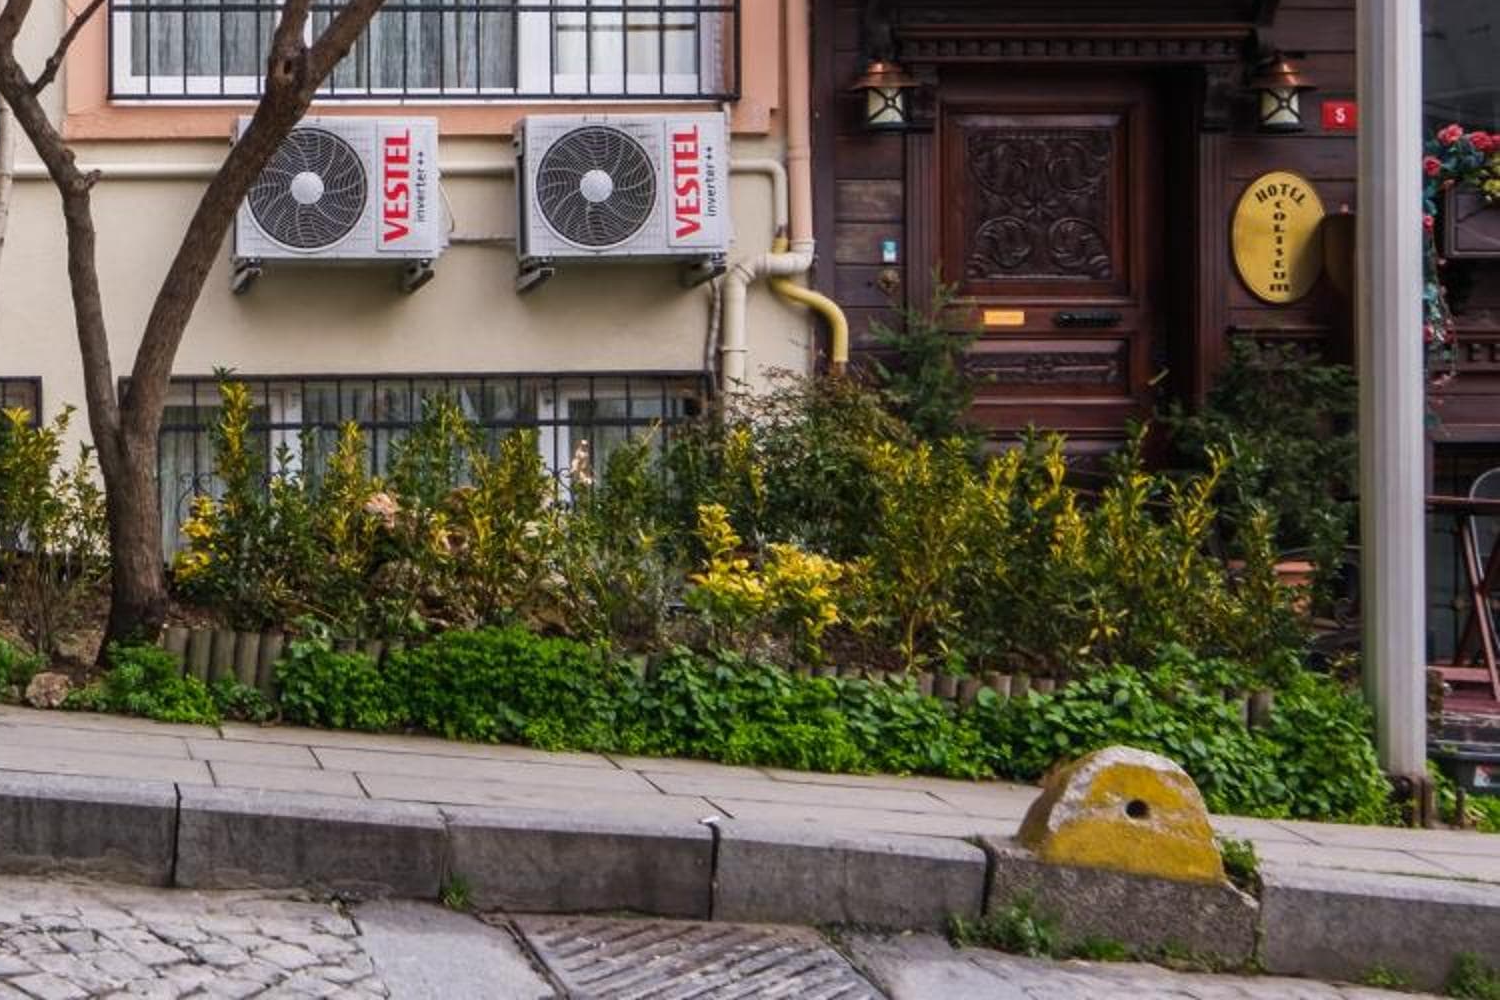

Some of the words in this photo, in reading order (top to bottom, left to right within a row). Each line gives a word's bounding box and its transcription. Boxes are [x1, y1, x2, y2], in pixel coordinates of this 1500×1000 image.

[383, 128, 410, 243] VESTEL
[673, 124, 702, 239] VESTEL
[1255, 183, 1306, 205] HOTEL
